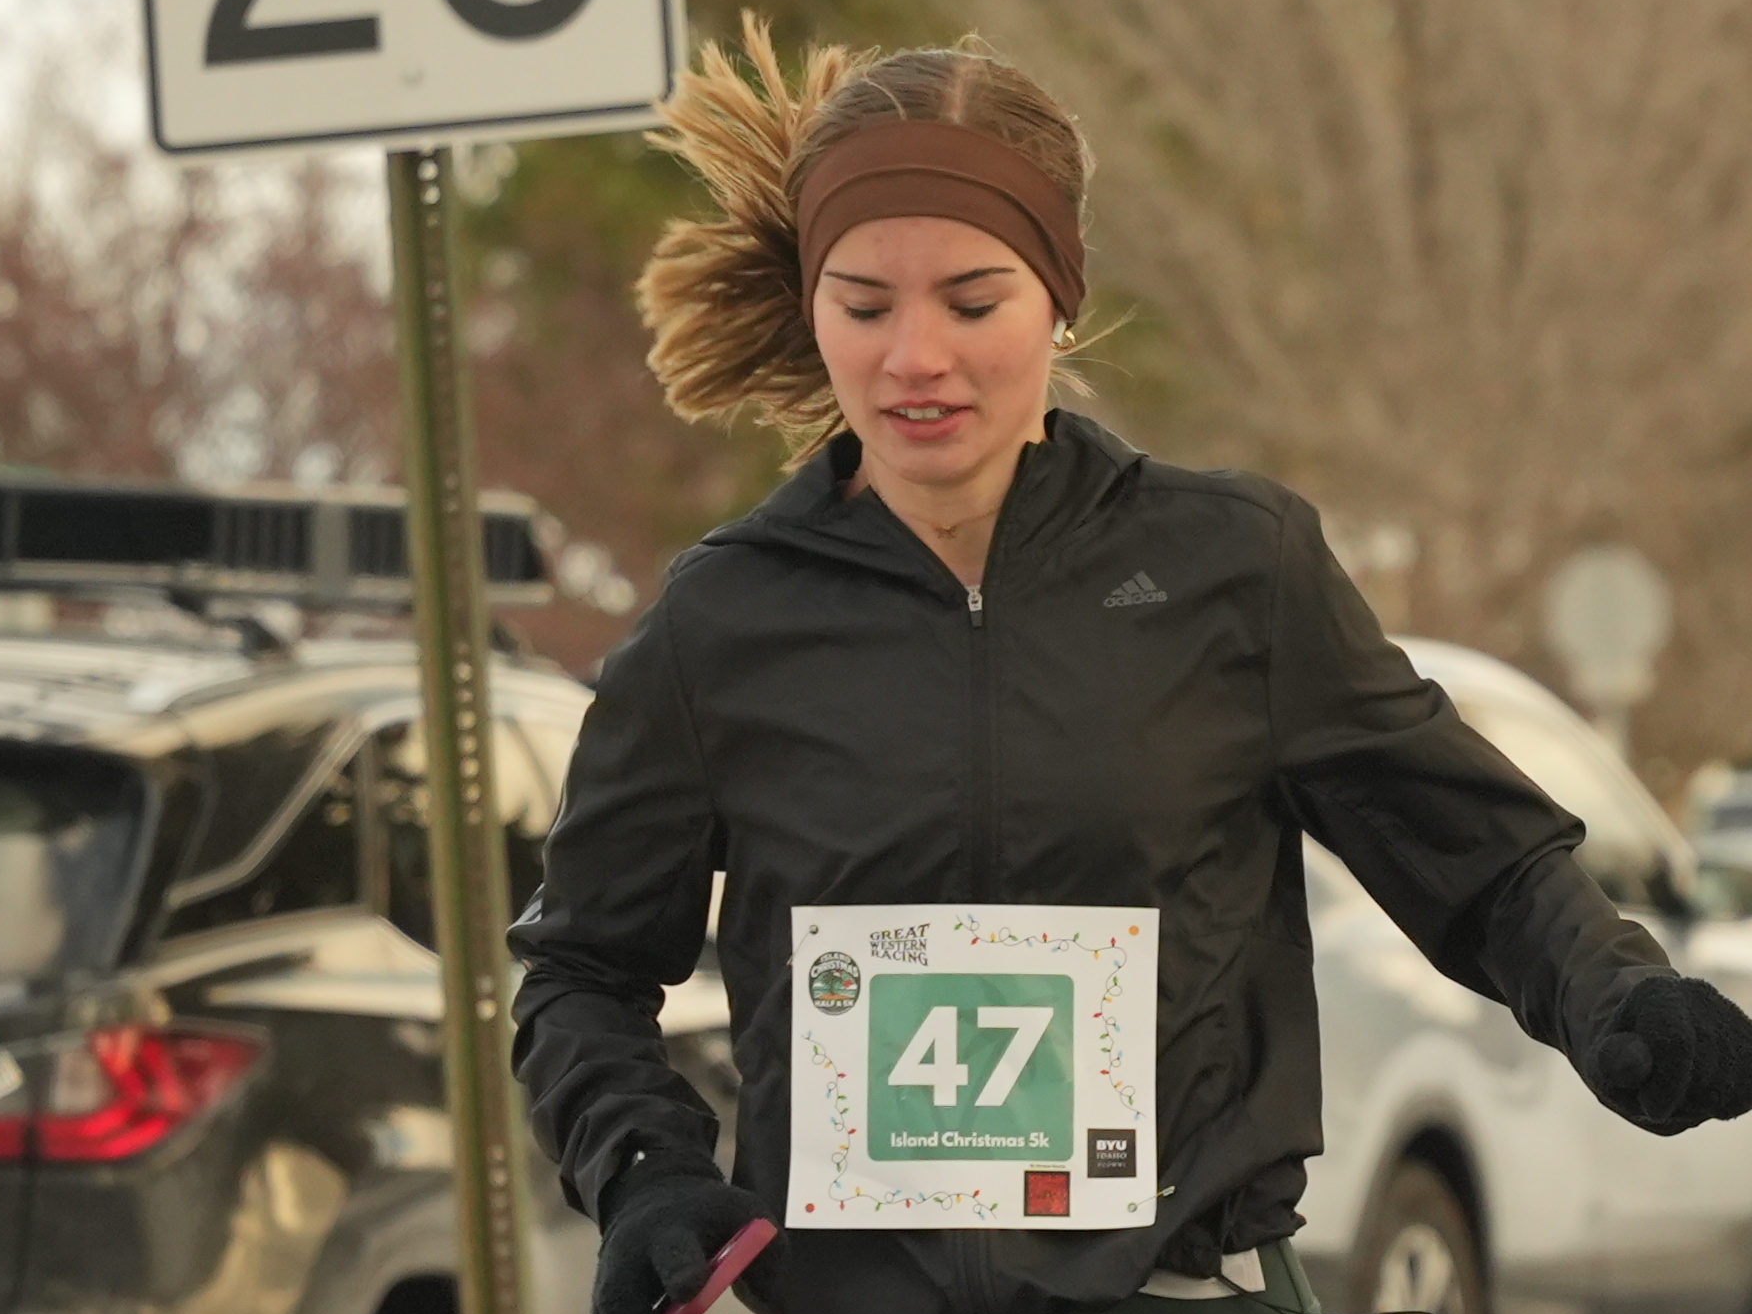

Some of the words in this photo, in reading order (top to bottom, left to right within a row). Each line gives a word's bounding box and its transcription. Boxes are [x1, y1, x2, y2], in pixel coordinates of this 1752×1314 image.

[1102, 589, 1168, 608] adidas
[869, 922, 931, 940] GREAT
[869, 938, 928, 952] WESTERN
[871, 949, 929, 967] RACING
[810, 959, 860, 979] CHRISTMAS
[887, 1005, 1055, 1107] 47
[890, 1131, 939, 1148] Island
[941, 1131, 1026, 1148] Christmas
[1028, 1131, 1050, 1149] 5k
[1096, 1139, 1128, 1152] BYU
[1096, 1152, 1128, 1161] IDAHO
